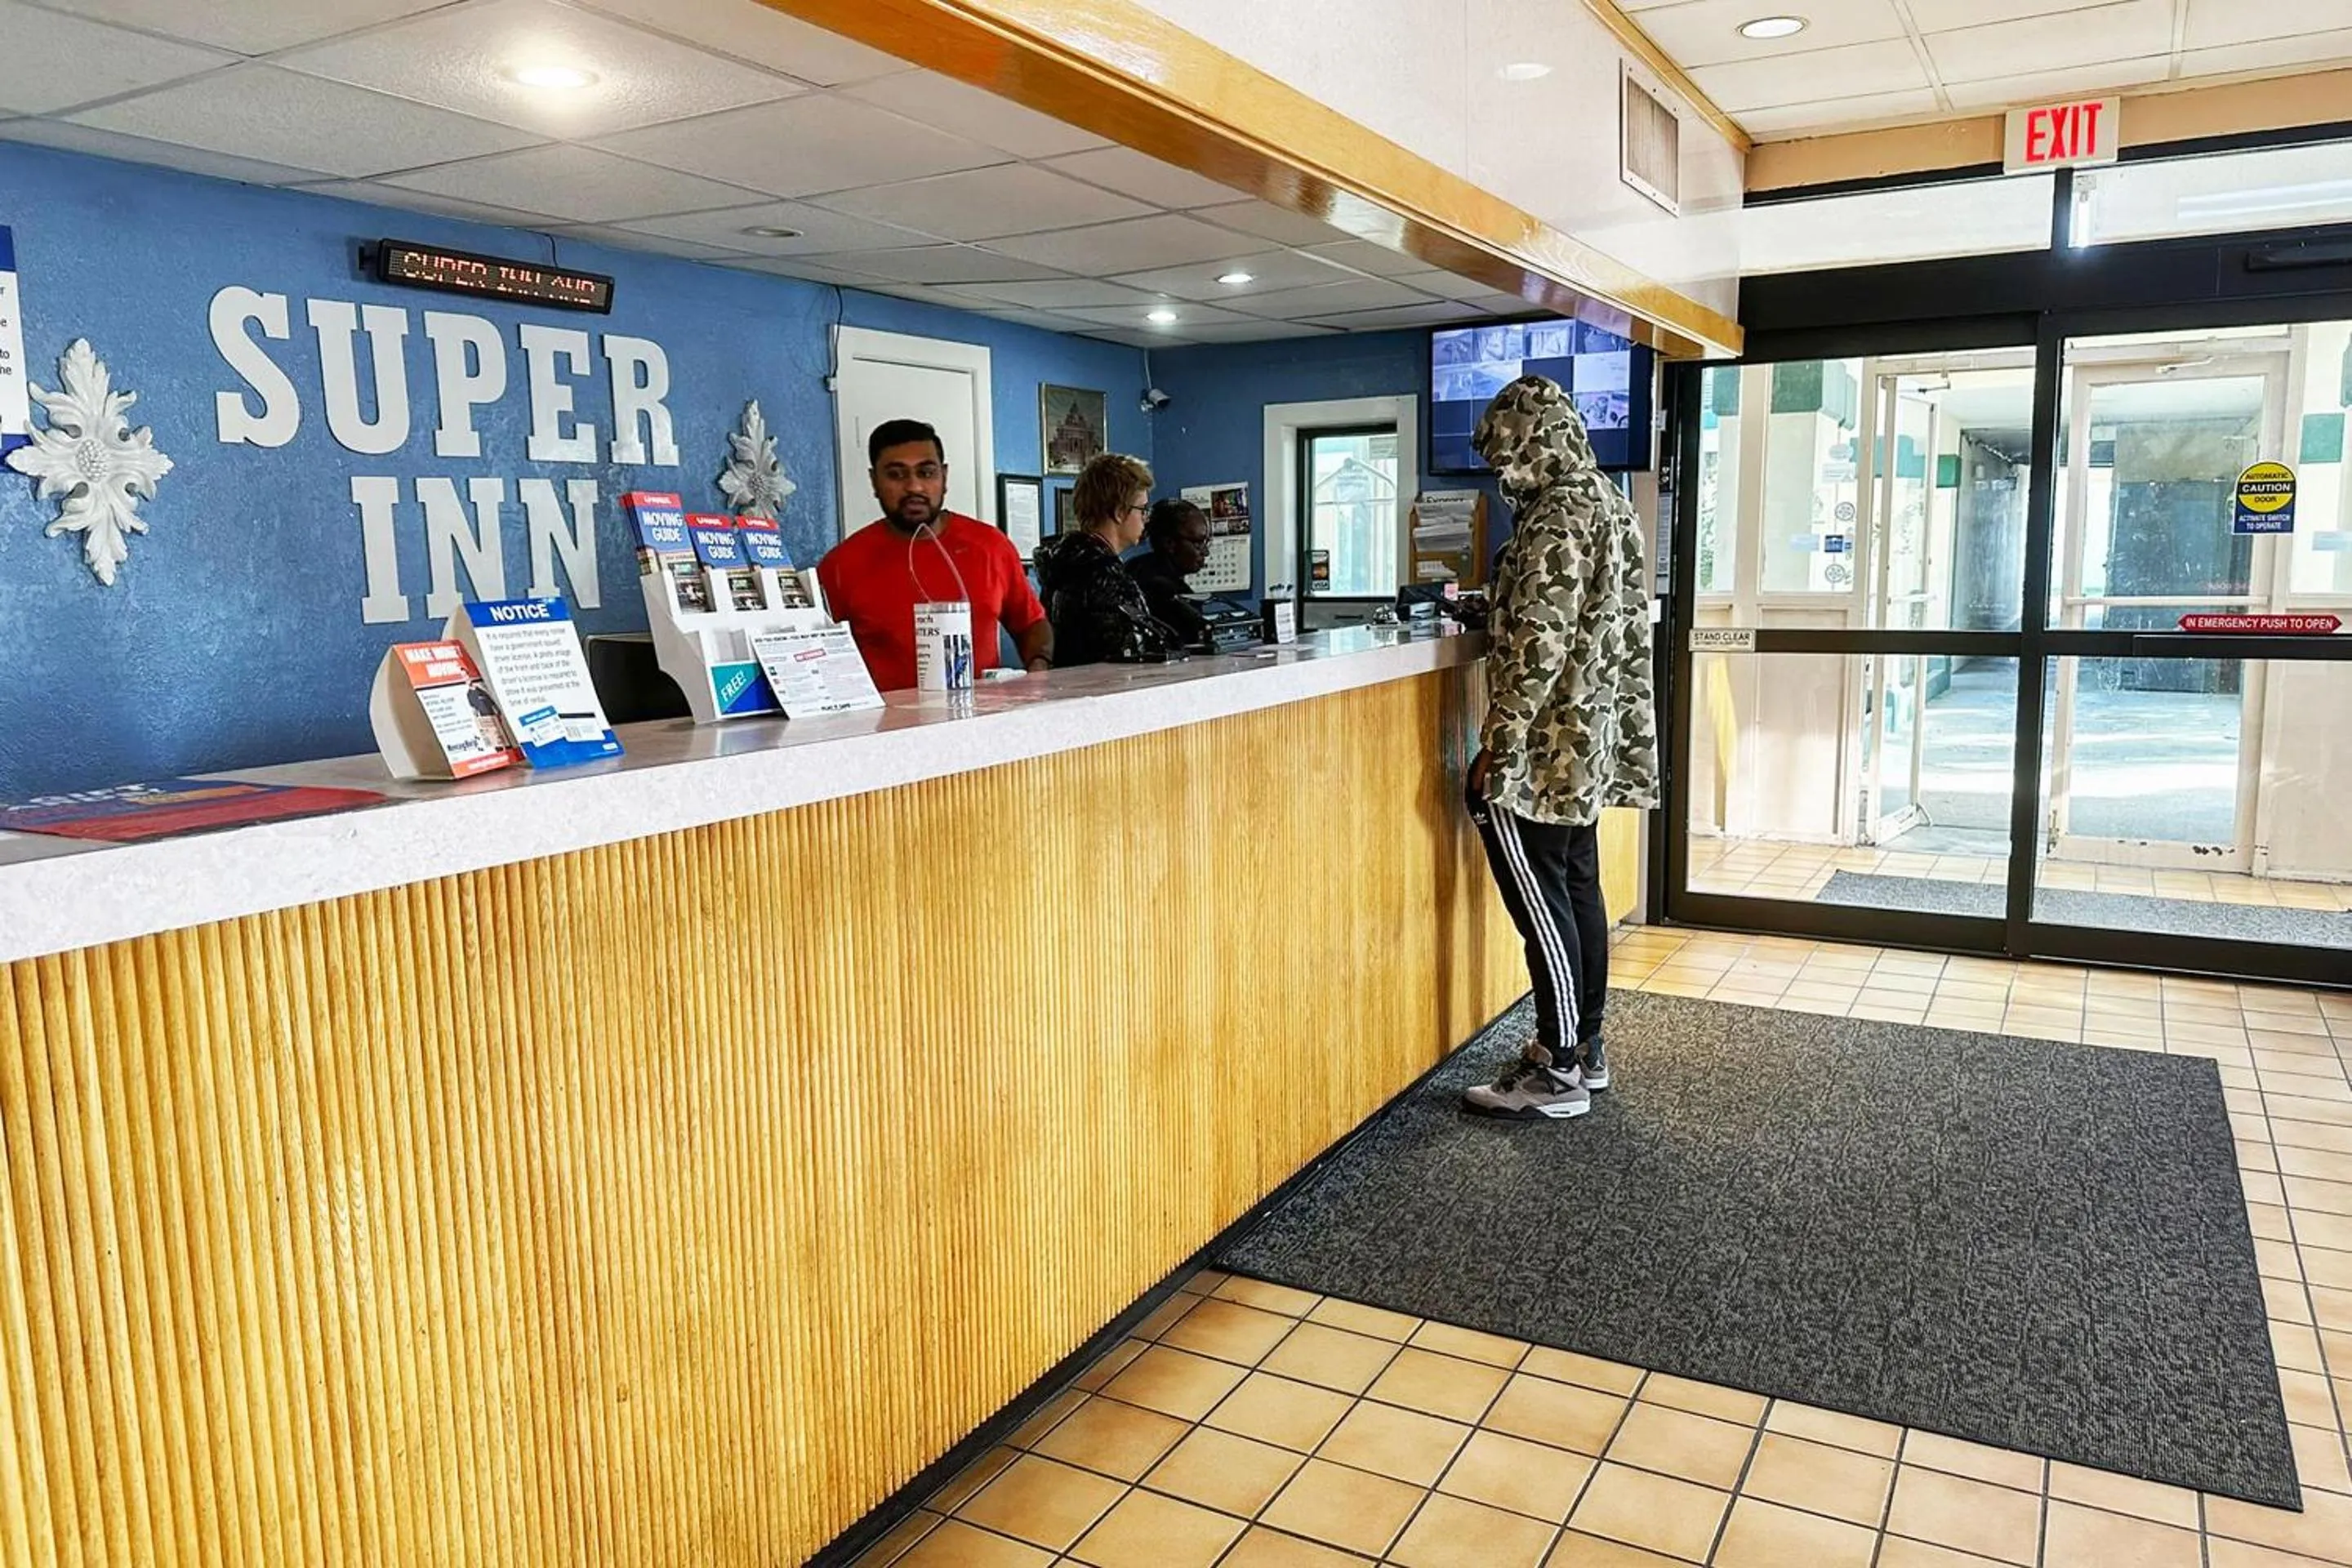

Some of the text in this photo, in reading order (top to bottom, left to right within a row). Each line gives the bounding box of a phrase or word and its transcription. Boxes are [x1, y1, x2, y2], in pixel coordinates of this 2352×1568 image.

[2026, 103, 2102, 162] EXIT
[209, 286, 679, 466] SUPER
[2245, 472, 2288, 480] AUTOMATIC
[2242, 483, 2291, 492] CAUTION
[642, 511, 683, 527] MOVING
[653, 528, 683, 542] GUIDE
[697, 531, 736, 546] MOVING
[746, 532, 782, 546] MOVING
[350, 476, 601, 624] INN
[708, 546, 736, 559] GUIDE
[756, 546, 783, 559] GUIDE
[489, 604, 550, 621] NOTICE
[2185, 617, 2333, 629] IN EMERGENCY PUSH TO OPEN
[1694, 632, 1750, 640] STAND CLEAR
[721, 670, 747, 702] FREE!
